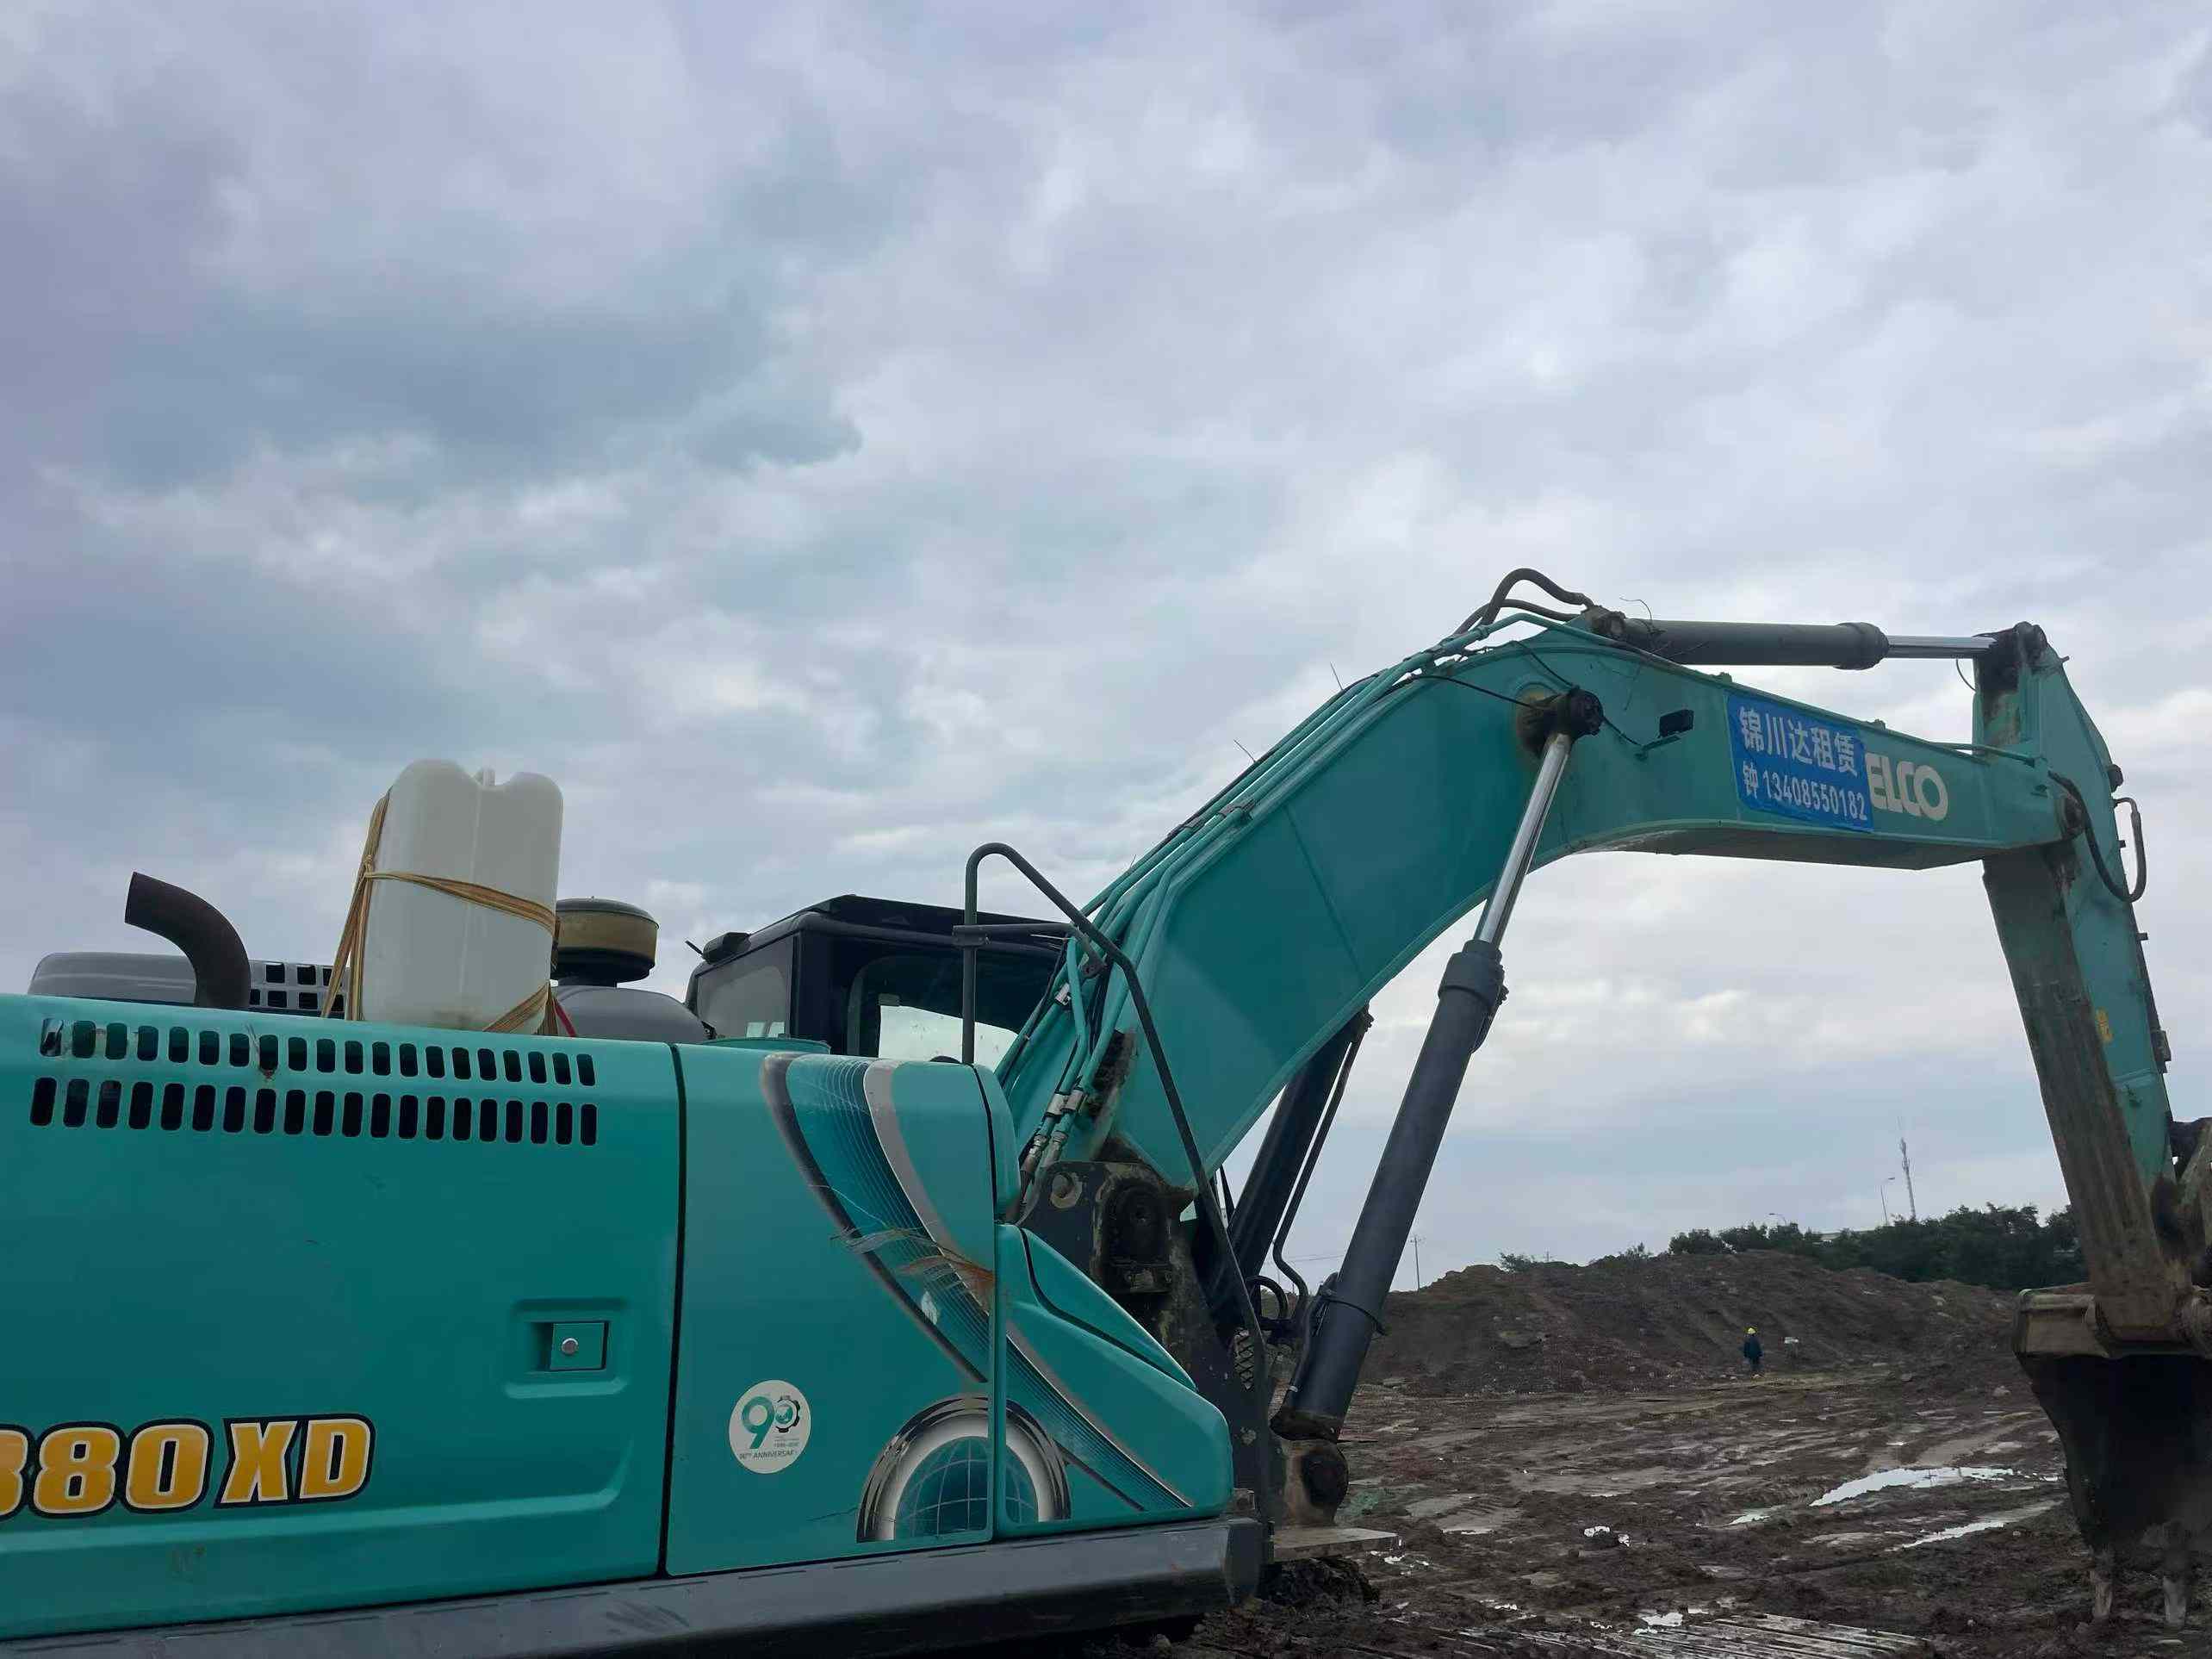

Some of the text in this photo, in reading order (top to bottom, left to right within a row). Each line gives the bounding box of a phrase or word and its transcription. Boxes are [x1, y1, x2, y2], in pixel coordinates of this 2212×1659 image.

[1739, 706, 1857, 776] 锦川达租赁
[1762, 769, 1867, 821] 13408550182
